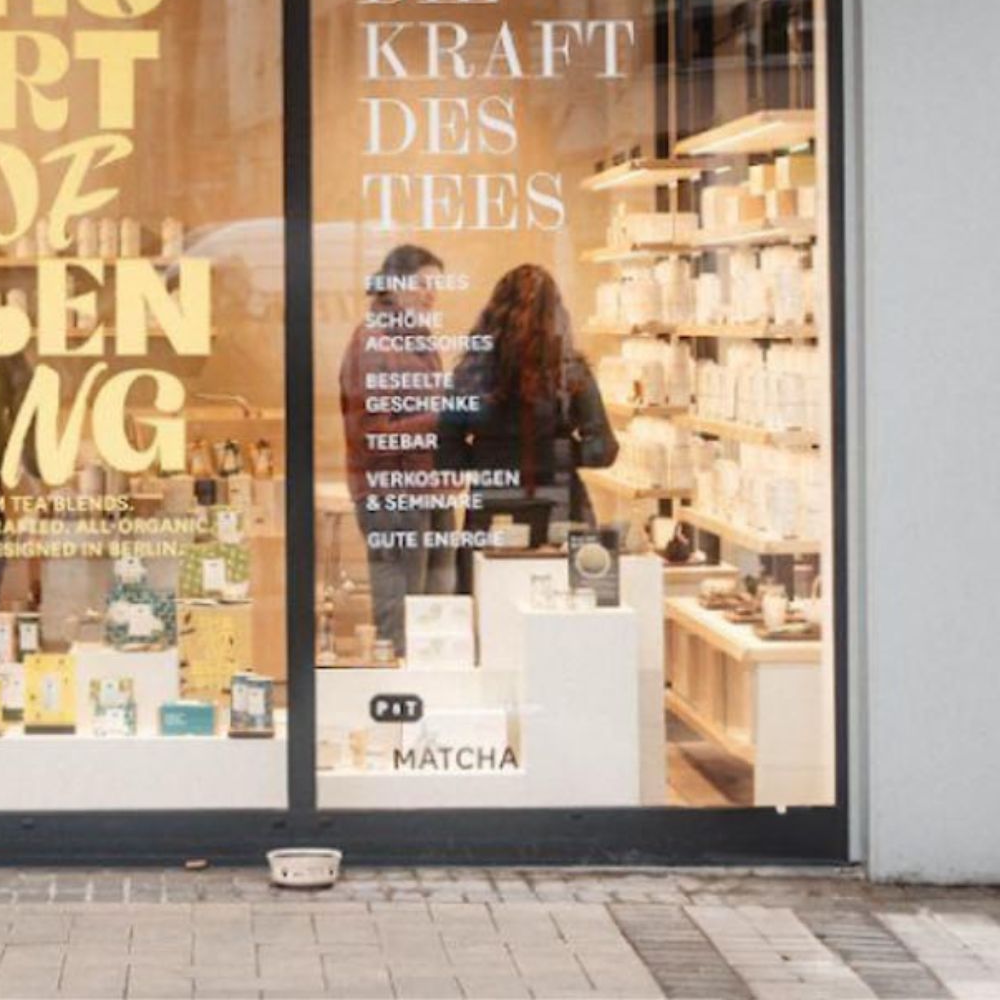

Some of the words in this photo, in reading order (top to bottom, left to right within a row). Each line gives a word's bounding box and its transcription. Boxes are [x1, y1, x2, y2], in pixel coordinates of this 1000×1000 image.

[360, 20, 635, 80] KRAFT
[359, 96, 518, 156] DES
[361, 172, 567, 232] TEES
[365, 274, 417, 291] FEINE
[425, 274, 470, 291] TEES
[365, 308, 444, 328] SCHÖNE
[365, 335, 494, 352] ACCESSOIRES
[365, 372, 454, 390] BESEELTE
[365, 396, 480, 413] GESCHENKE
[365, 433, 439, 450] TEEBAR
[365, 470, 521, 489] VERKOSTUNGEN
[11, 496, 47, 513] TEA
[54, 495, 135, 512] BLENDS.
[366, 494, 381, 511] &
[384, 493, 484, 511] SEMINARE
[367, 531, 418, 549] GUTE
[423, 530, 505, 549] ENERGIE
[81, 541, 103, 559] IN
[109, 540, 185, 558] BERLIN.
[376, 700, 389, 717] P
[405, 700, 419, 716] T
[392, 746, 519, 771] MATCHA
